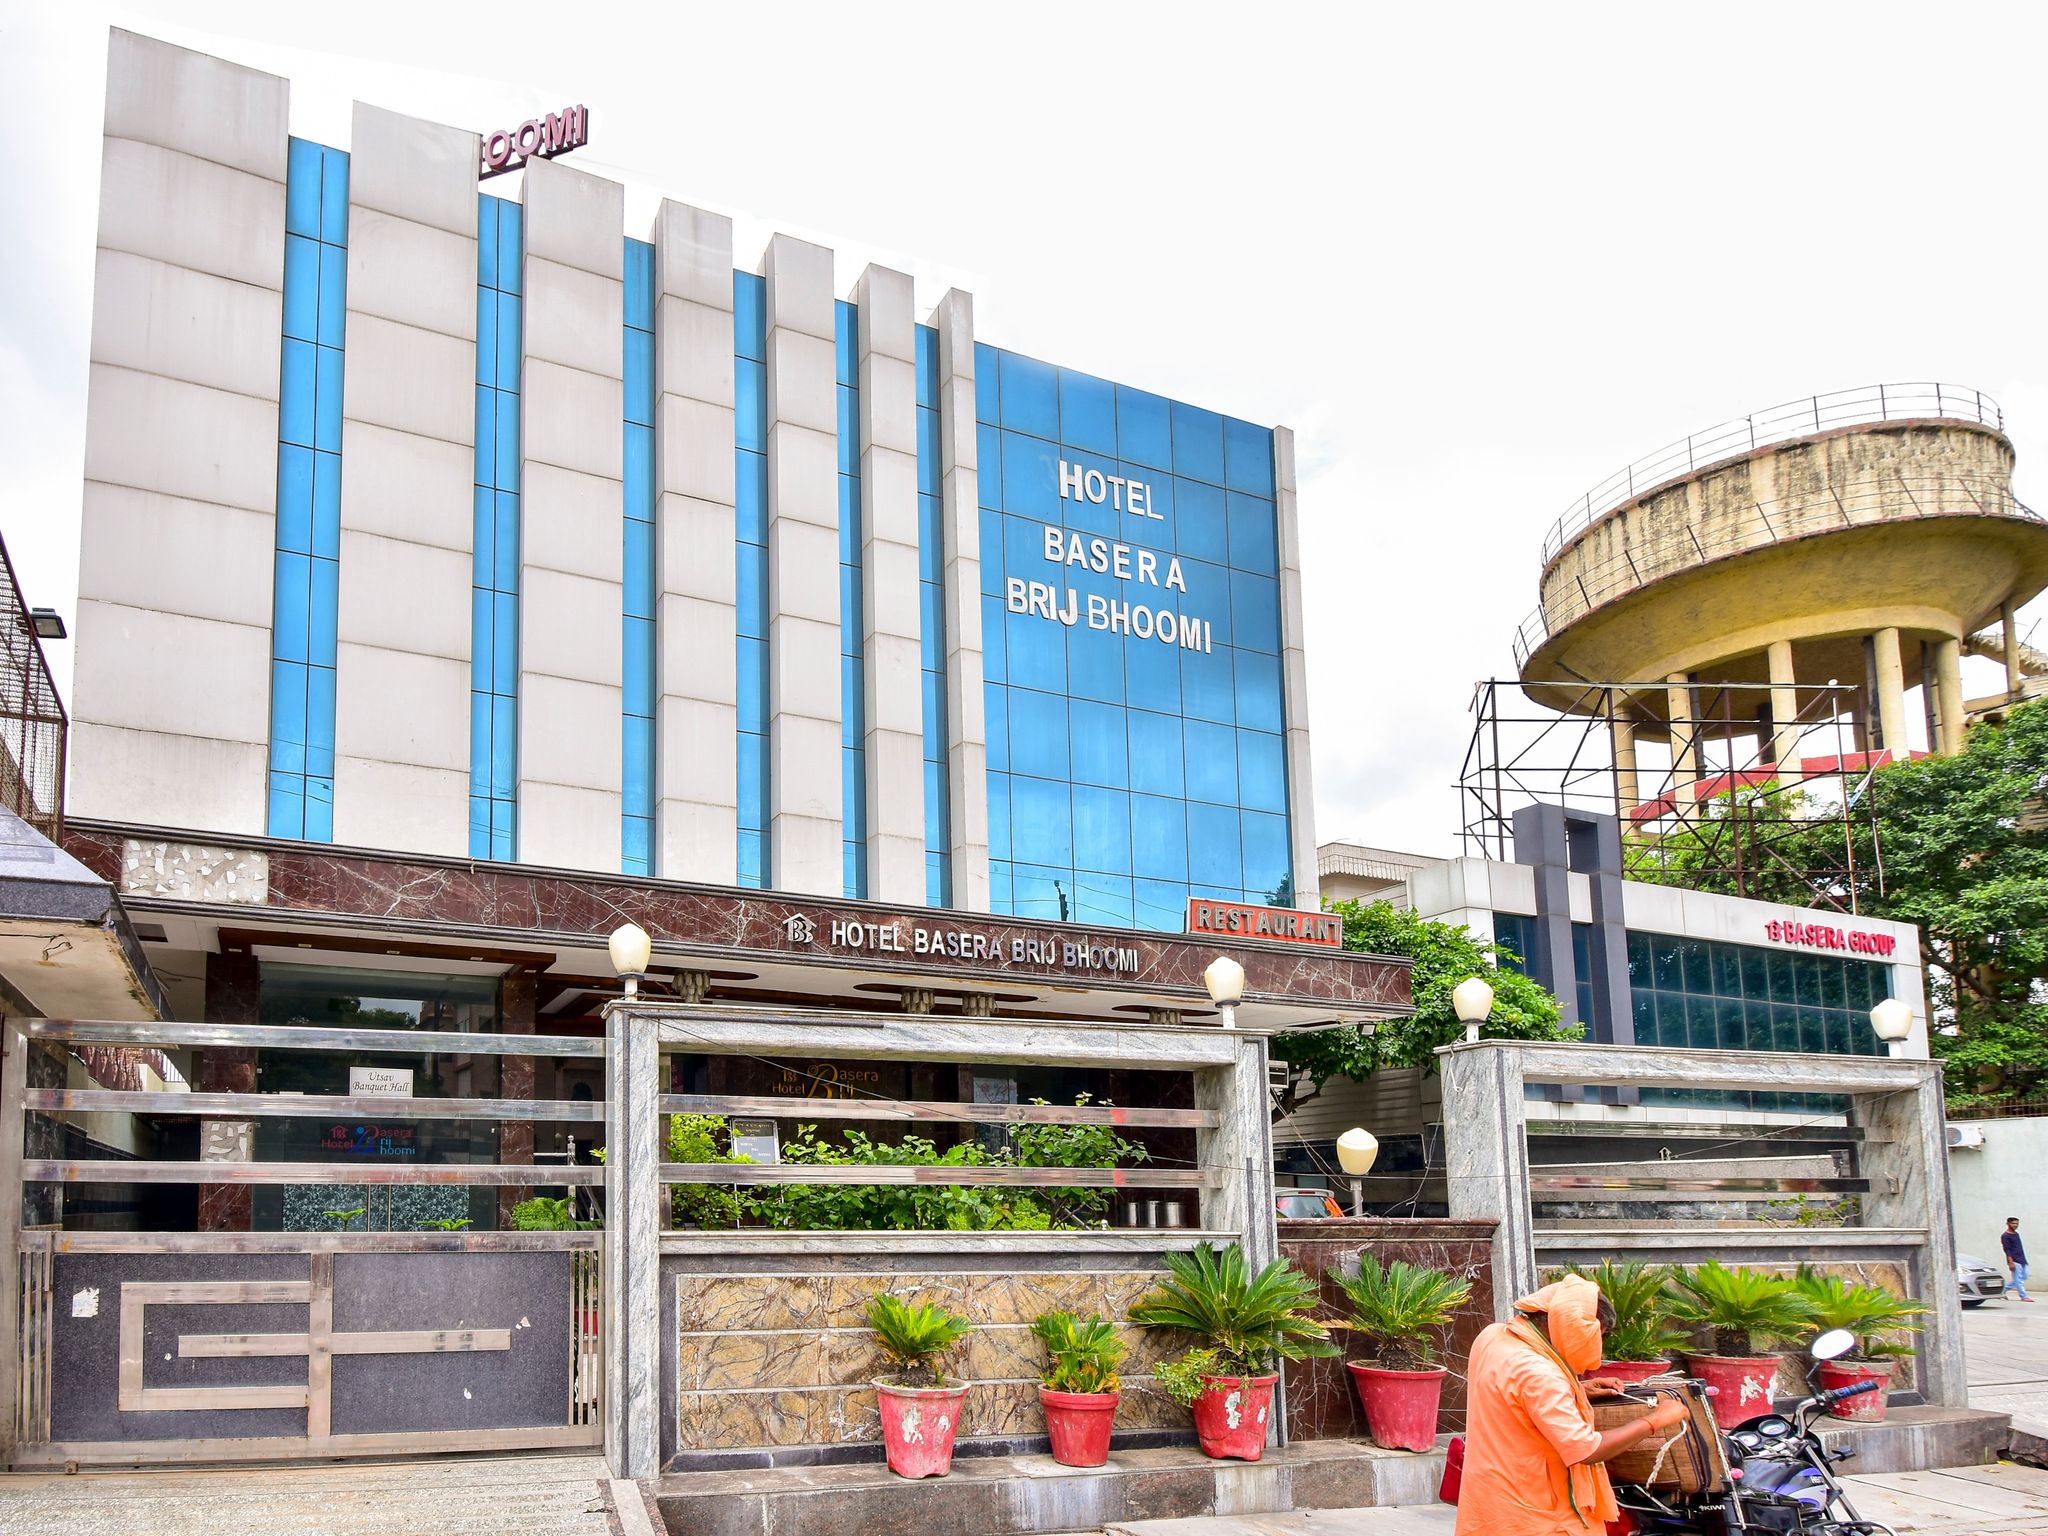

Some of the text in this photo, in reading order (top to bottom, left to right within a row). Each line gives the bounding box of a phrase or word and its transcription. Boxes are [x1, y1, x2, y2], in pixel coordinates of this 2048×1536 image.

[1058, 460, 1165, 521] HOTEL
[1043, 525, 1187, 593] BASERA
[1006, 576, 1212, 655] BRIJ BHOOMI
[1197, 904, 1341, 943] RESTAURANT
[1783, 920, 1897, 957] BASERA GROUP
[831, 920, 1139, 973] HOTEL BASERA BRIJ BHOOMI
[352, 1081, 410, 1094] Banquet Hall
[368, 1071, 395, 1082] Utsav
[772, 1082, 806, 1095] Hotel
[321, 1139, 354, 1149] Hotel
